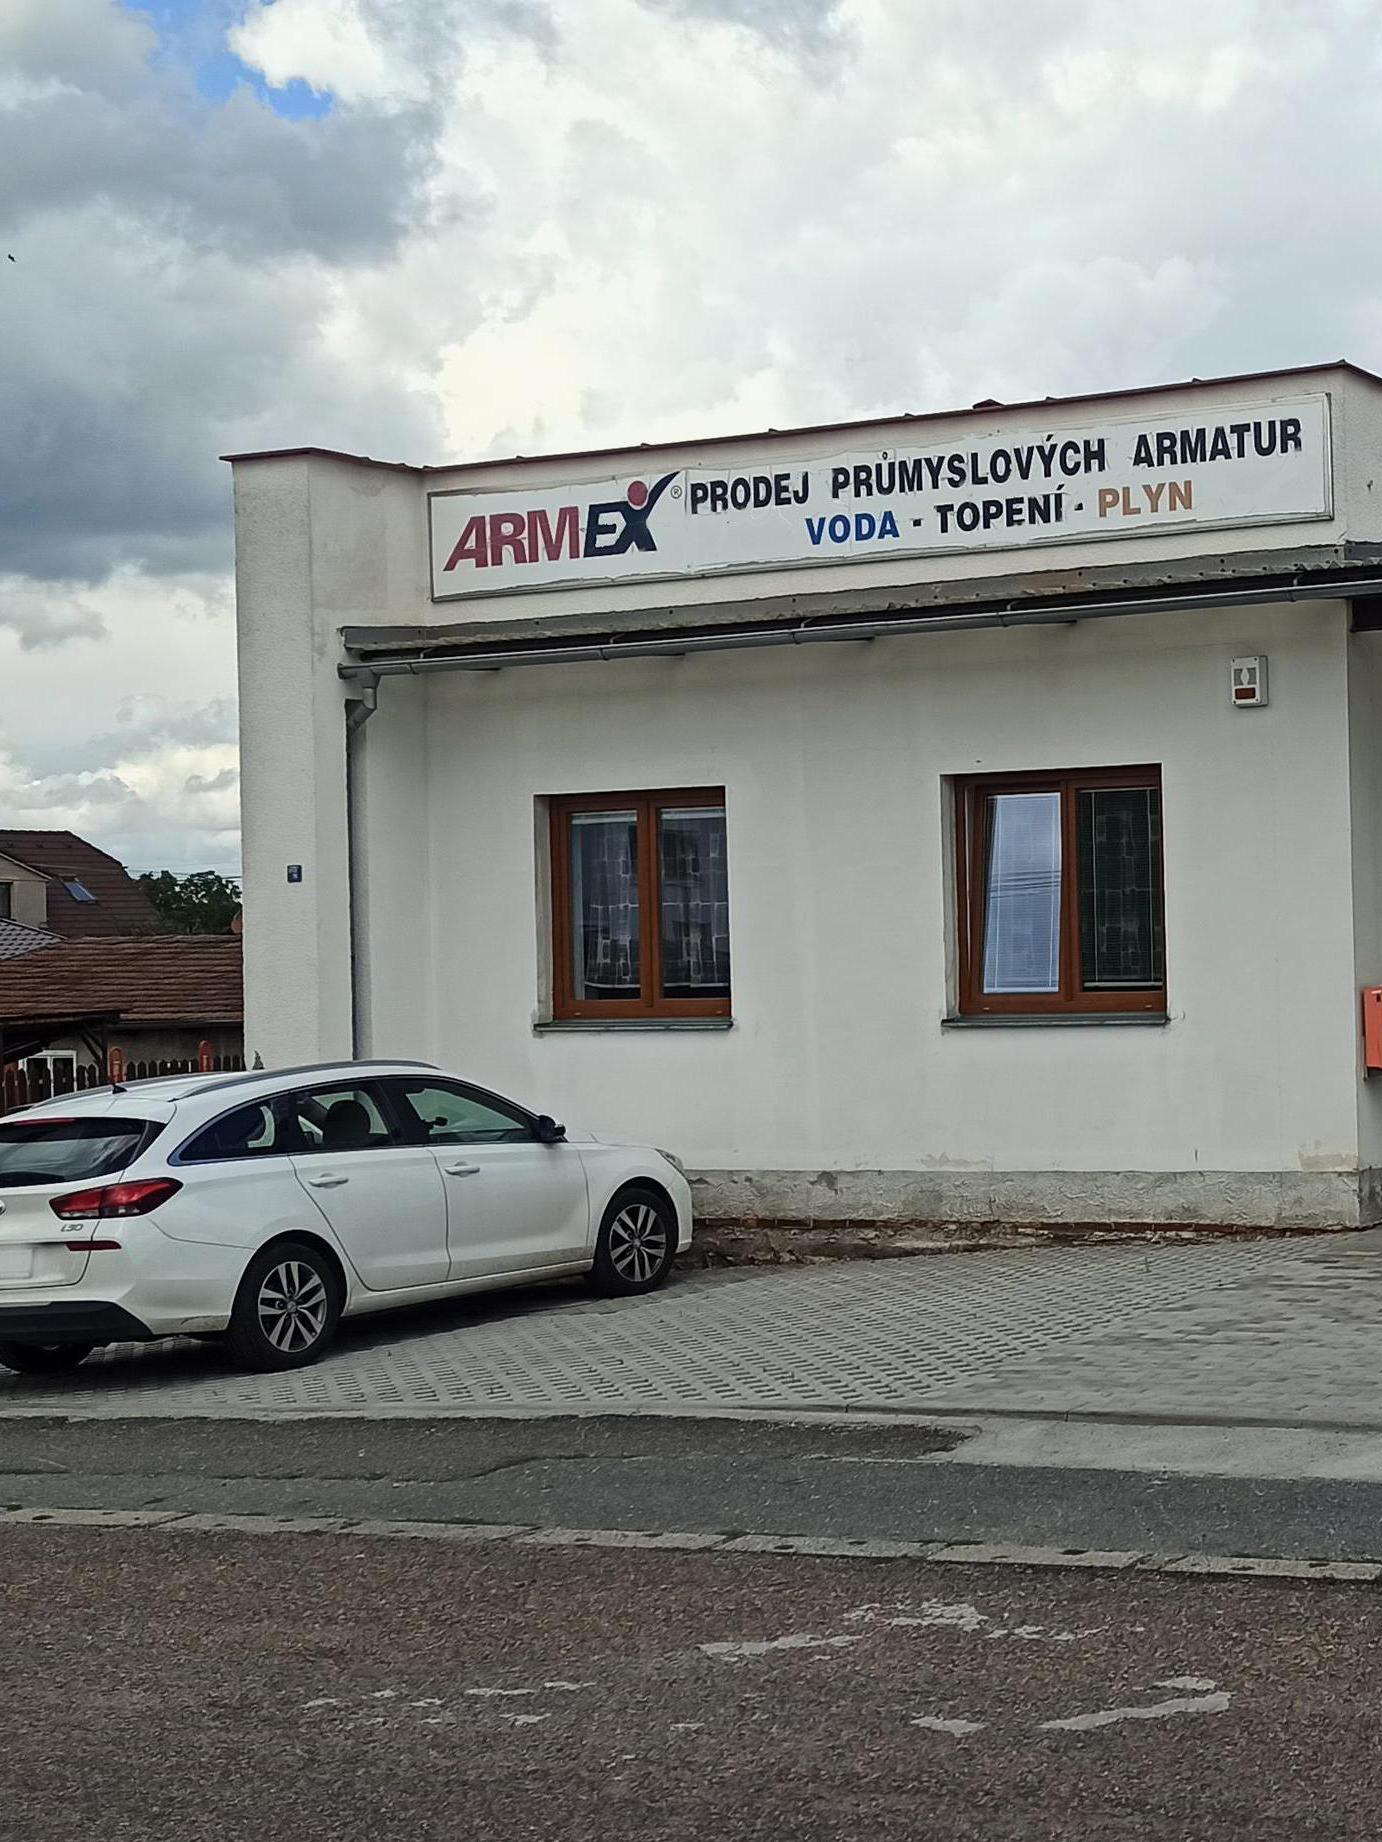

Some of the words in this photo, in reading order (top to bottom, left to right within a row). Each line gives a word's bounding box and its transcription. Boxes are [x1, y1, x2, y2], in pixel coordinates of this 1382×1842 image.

[690, 471, 809, 514] PRODEJ
[832, 434, 1106, 498] PRŮMYSLOVÝCH
[1133, 417, 1302, 468] ARMATUR
[806, 510, 900, 545] VODA
[936, 484, 1065, 533] TOPENÍ
[1098, 480, 1193, 518] PLYN
[443, 471, 680, 571] ARMEX
